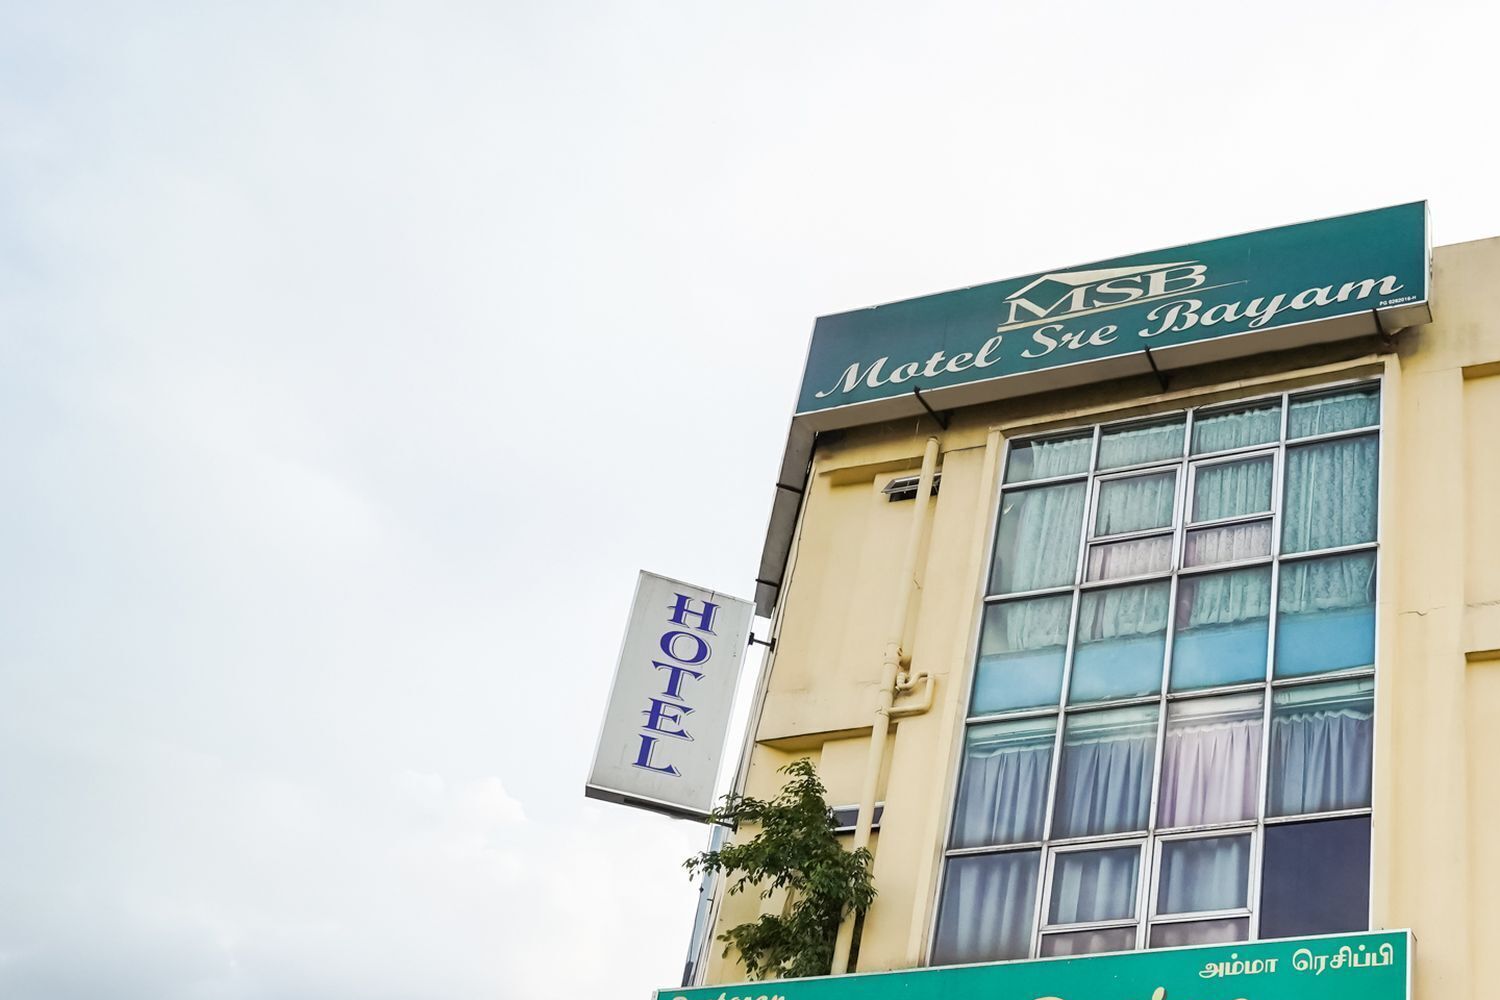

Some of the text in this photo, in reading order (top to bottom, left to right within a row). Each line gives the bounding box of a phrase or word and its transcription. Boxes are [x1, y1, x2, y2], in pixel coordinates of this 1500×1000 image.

[814, 274, 1404, 398] Motel Sre Bayam
[999, 264, 1208, 326] MSB
[632, 592, 721, 777] HOTEL
[1198, 942, 1394, 979] அம்மா ரெசிப்பி
